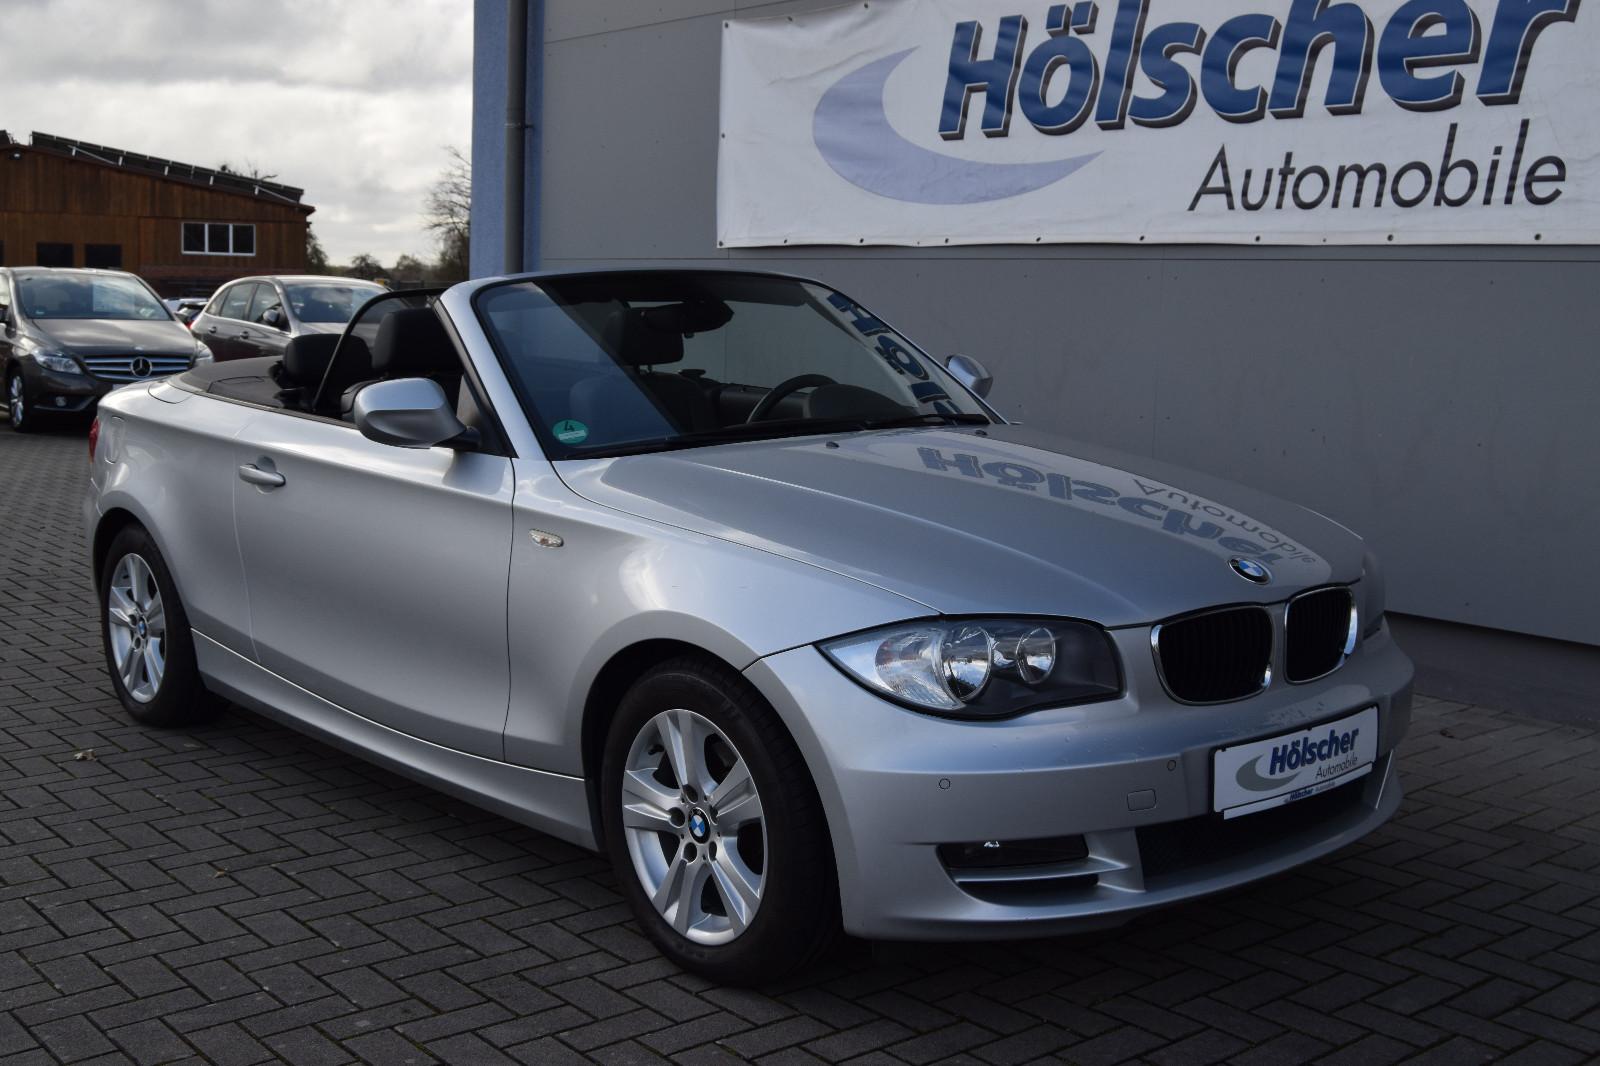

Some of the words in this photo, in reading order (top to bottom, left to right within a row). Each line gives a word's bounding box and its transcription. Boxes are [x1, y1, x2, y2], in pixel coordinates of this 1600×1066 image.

[938, 0, 1581, 140] Hölscher
[1187, 118, 1566, 211] Automobile
[1269, 728, 1359, 776] Hölscher
[1315, 752, 1358, 780] Automobile
